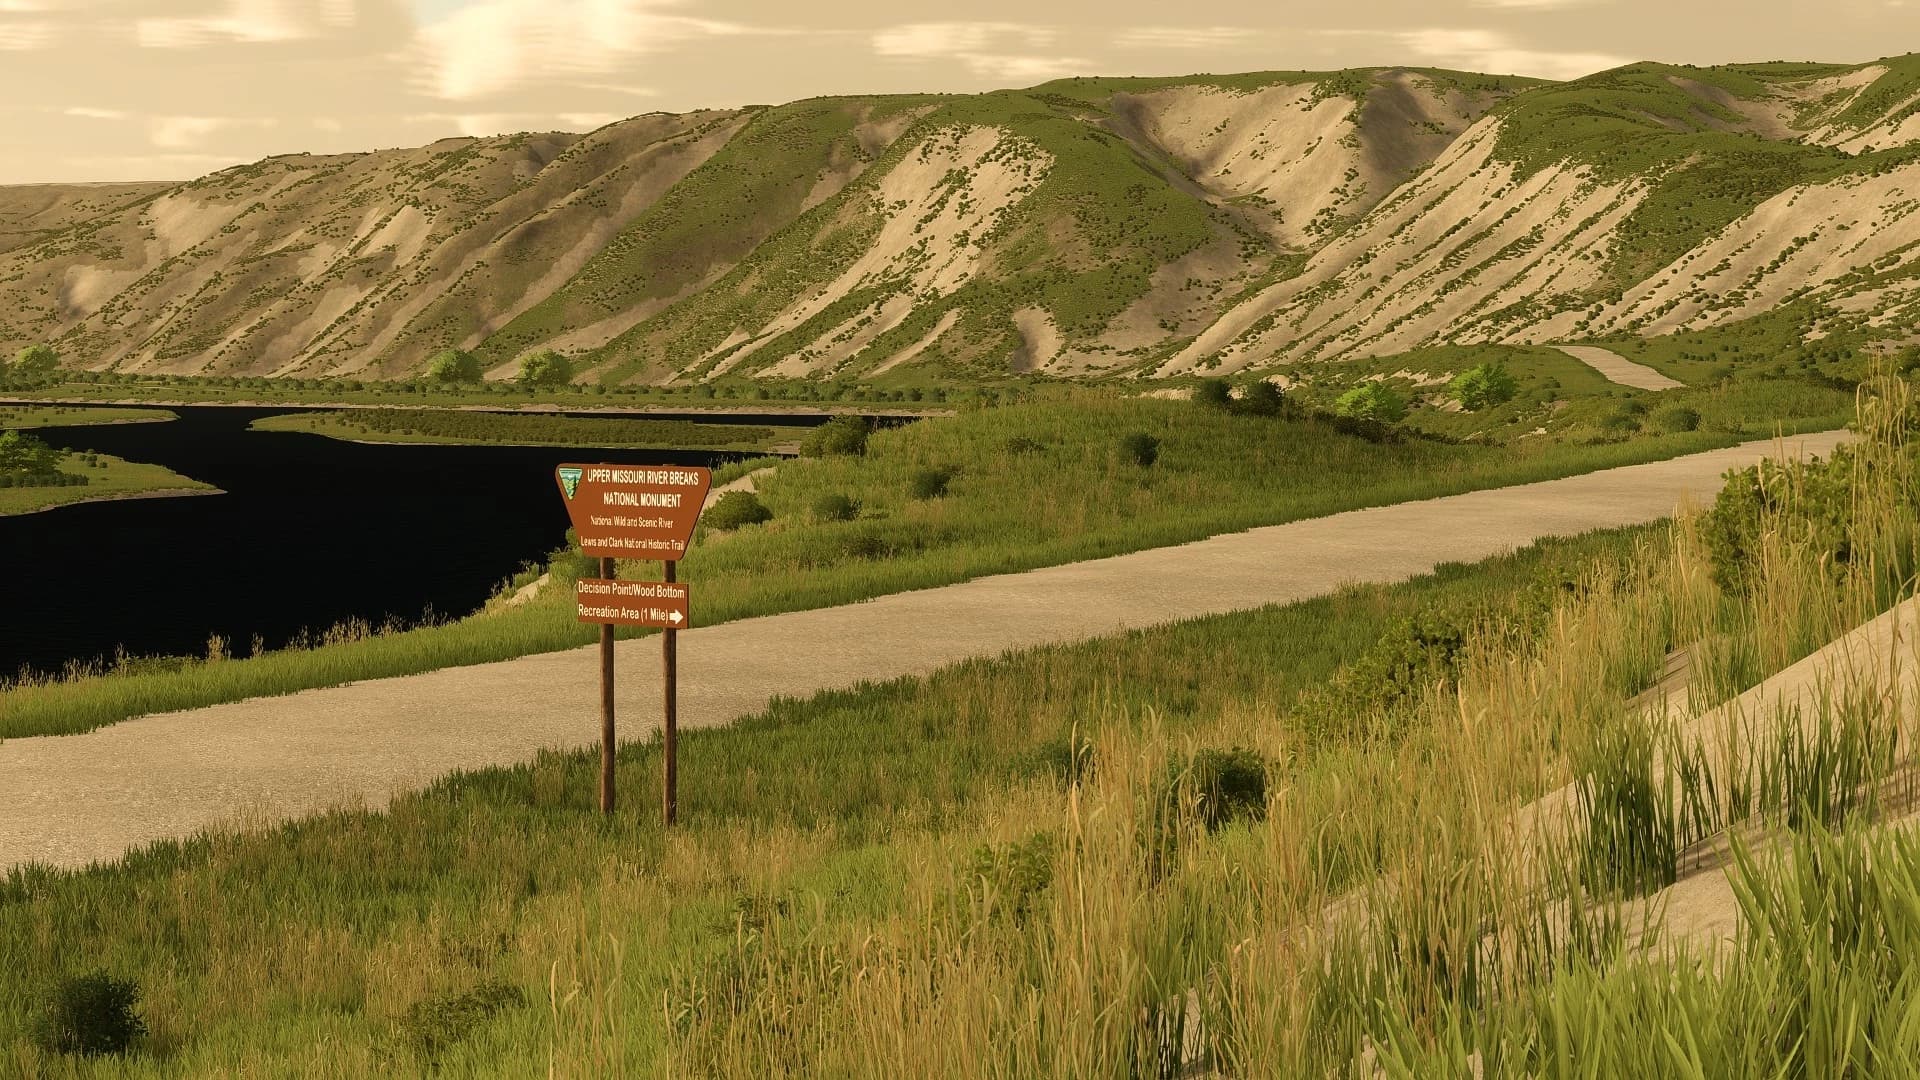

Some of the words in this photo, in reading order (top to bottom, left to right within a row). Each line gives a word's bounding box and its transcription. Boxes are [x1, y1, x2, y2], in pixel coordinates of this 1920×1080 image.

[588, 469, 611, 483] UPPER
[612, 470, 646, 484] MISSOURI
[647, 471, 669, 485] RIVER
[670, 471, 698, 486] BREAKS
[604, 492, 639, 506] NATIONAL
[640, 493, 681, 508] MONUMENT
[614, 516, 626, 527] Wild
[626, 517, 638, 528] and
[638, 517, 657, 528] Scenic
[658, 517, 674, 529] River
[580, 536, 596, 547] Lewis
[596, 536, 608, 547] and
[609, 537, 623, 548] Clark
[624, 537, 648, 549] National
[648, 538, 670, 550] Historic
[670, 539, 684, 551] Trail
[578, 581, 610, 594] Decision
[612, 583, 655, 597] Point/Wood
[657, 585, 685, 599] Bottom
[578, 604, 619, 618] Recreation
[620, 606, 639, 619] Area
[640, 608, 648, 623] (1
[650, 608, 669, 624] Mile)
